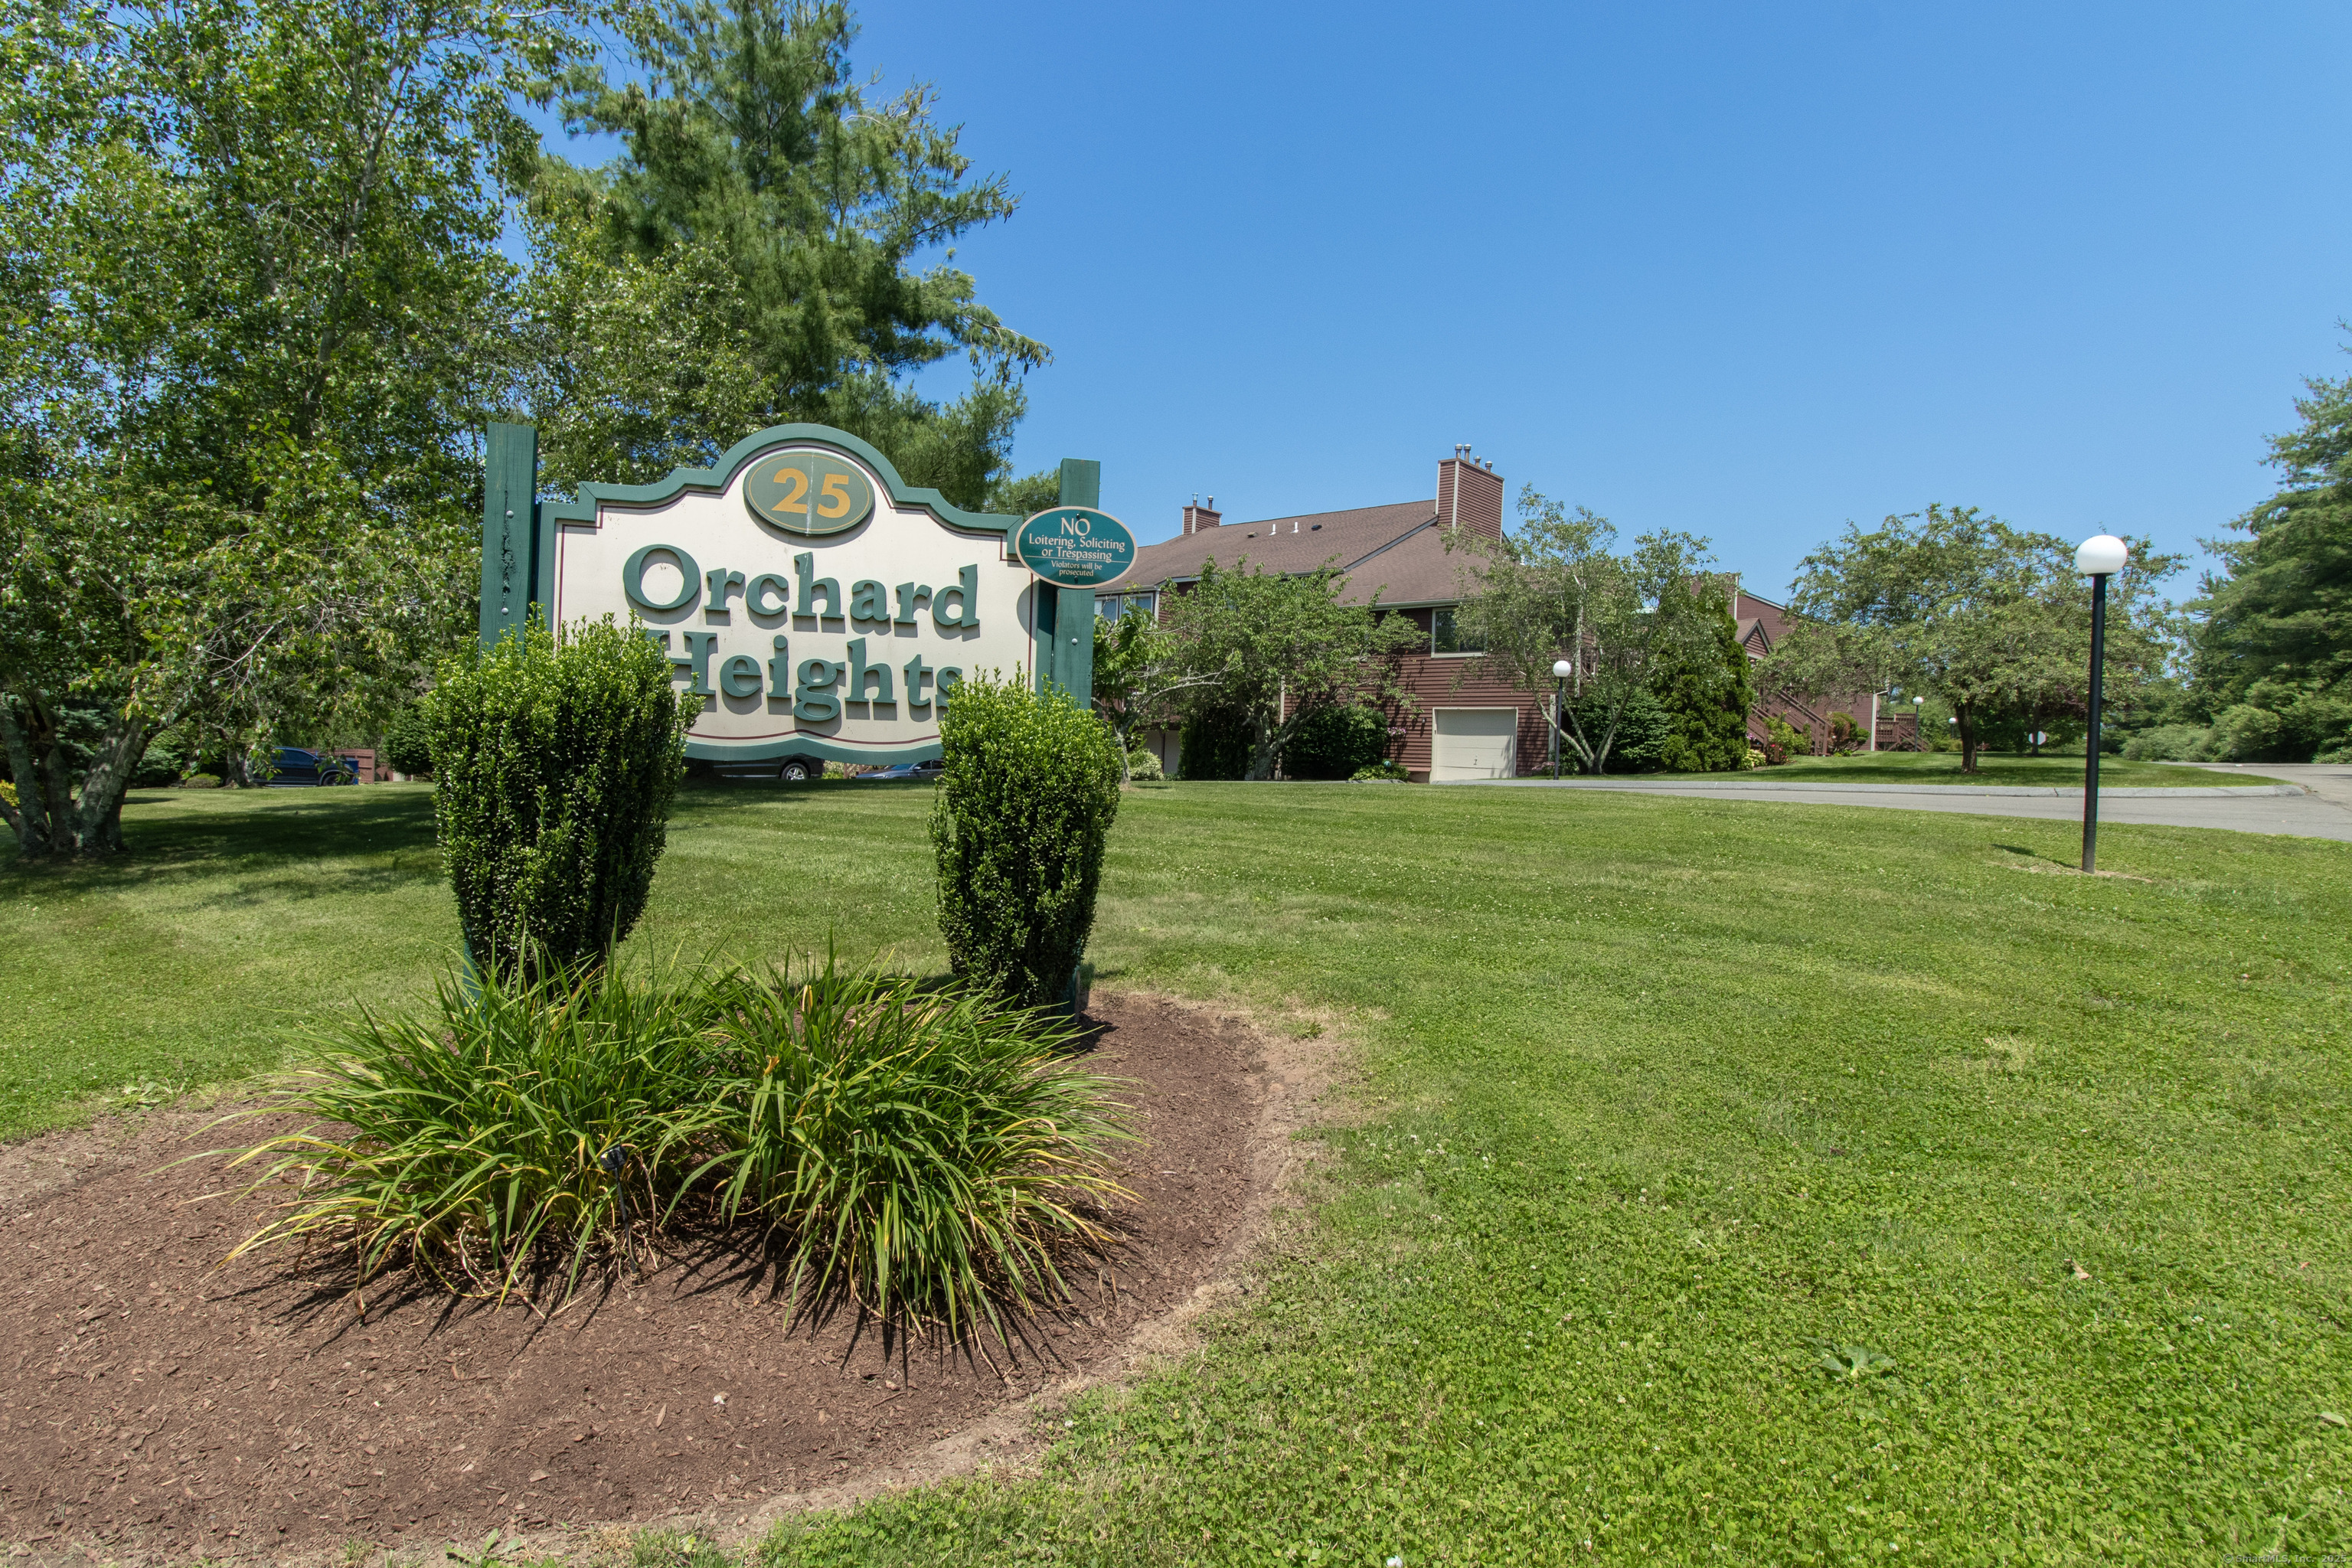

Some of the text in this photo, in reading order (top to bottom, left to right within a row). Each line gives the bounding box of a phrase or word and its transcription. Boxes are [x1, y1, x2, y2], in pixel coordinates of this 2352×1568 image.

[771, 468, 851, 518] 25
[1060, 517, 1091, 536] NO
[1029, 533, 1125, 553] Loitering, Soliciting
[1041, 546, 1112, 563] or Trespassing
[1050, 560, 1080, 569] Violators
[622, 544, 980, 629] Orchard
[640, 629, 963, 722] Heights
